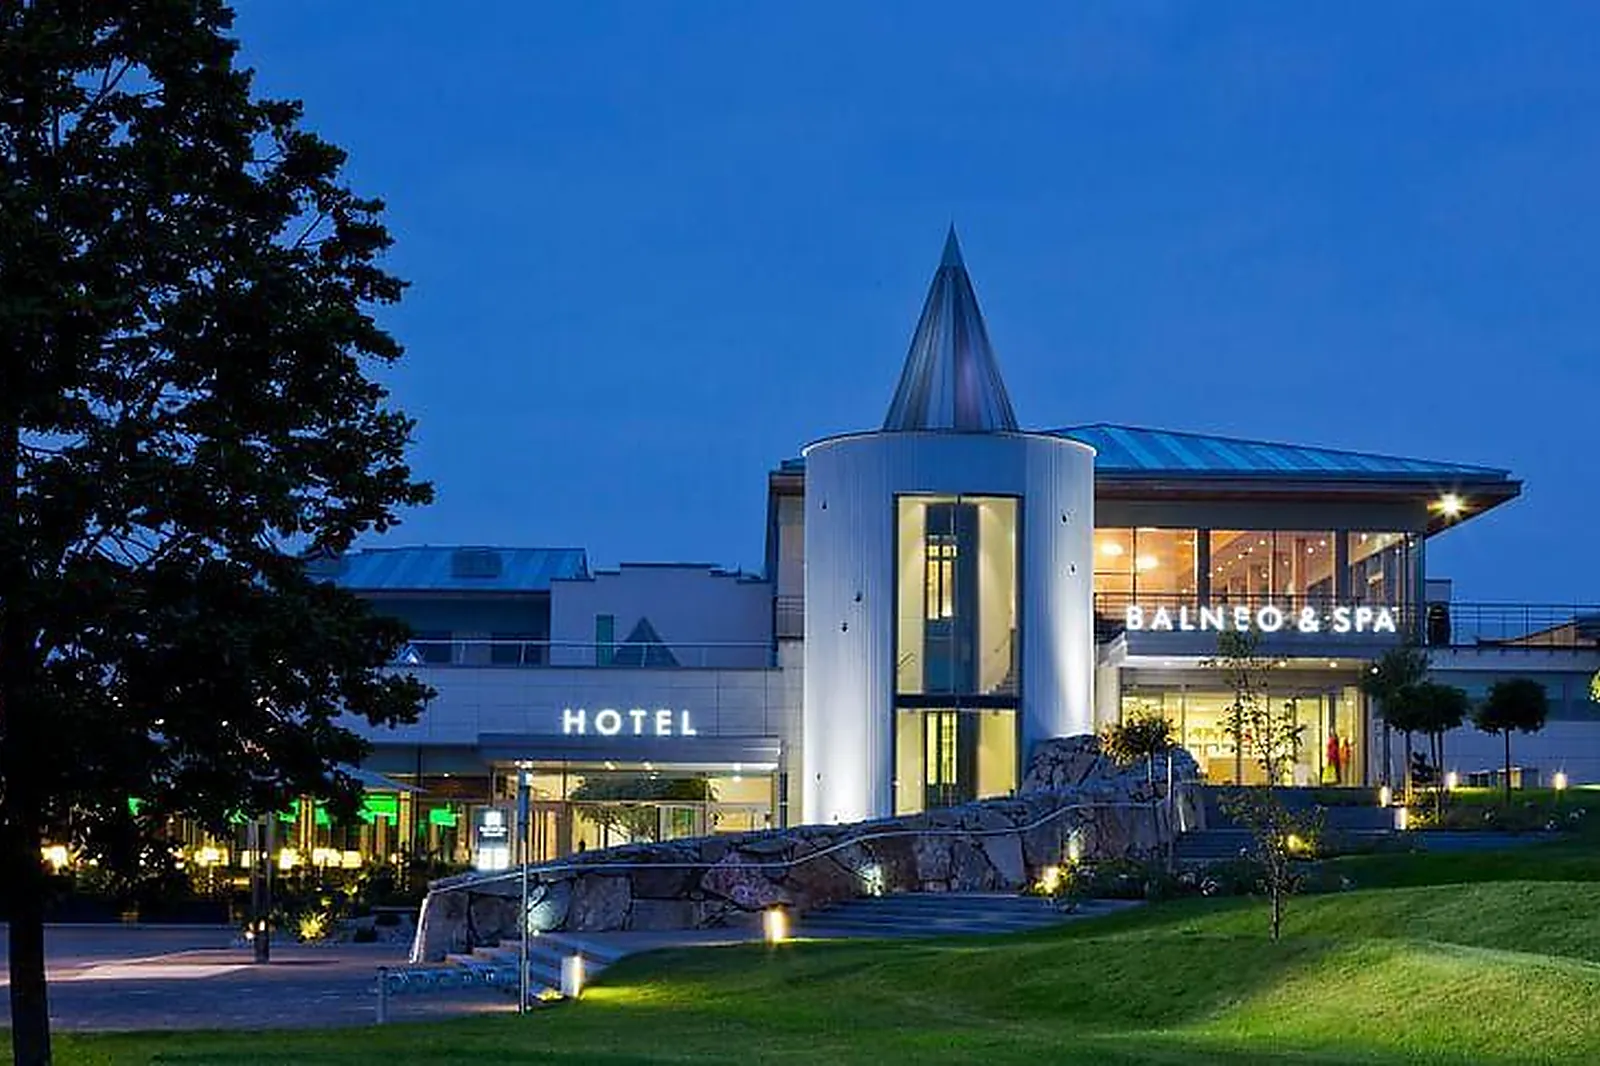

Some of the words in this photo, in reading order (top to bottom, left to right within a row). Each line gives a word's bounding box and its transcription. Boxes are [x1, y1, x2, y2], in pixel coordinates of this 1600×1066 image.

[1126, 606, 1282, 632] BALNEO
[1299, 607, 1319, 633] &
[1333, 607, 1395, 632] SPA
[563, 709, 697, 735] HOTEL
